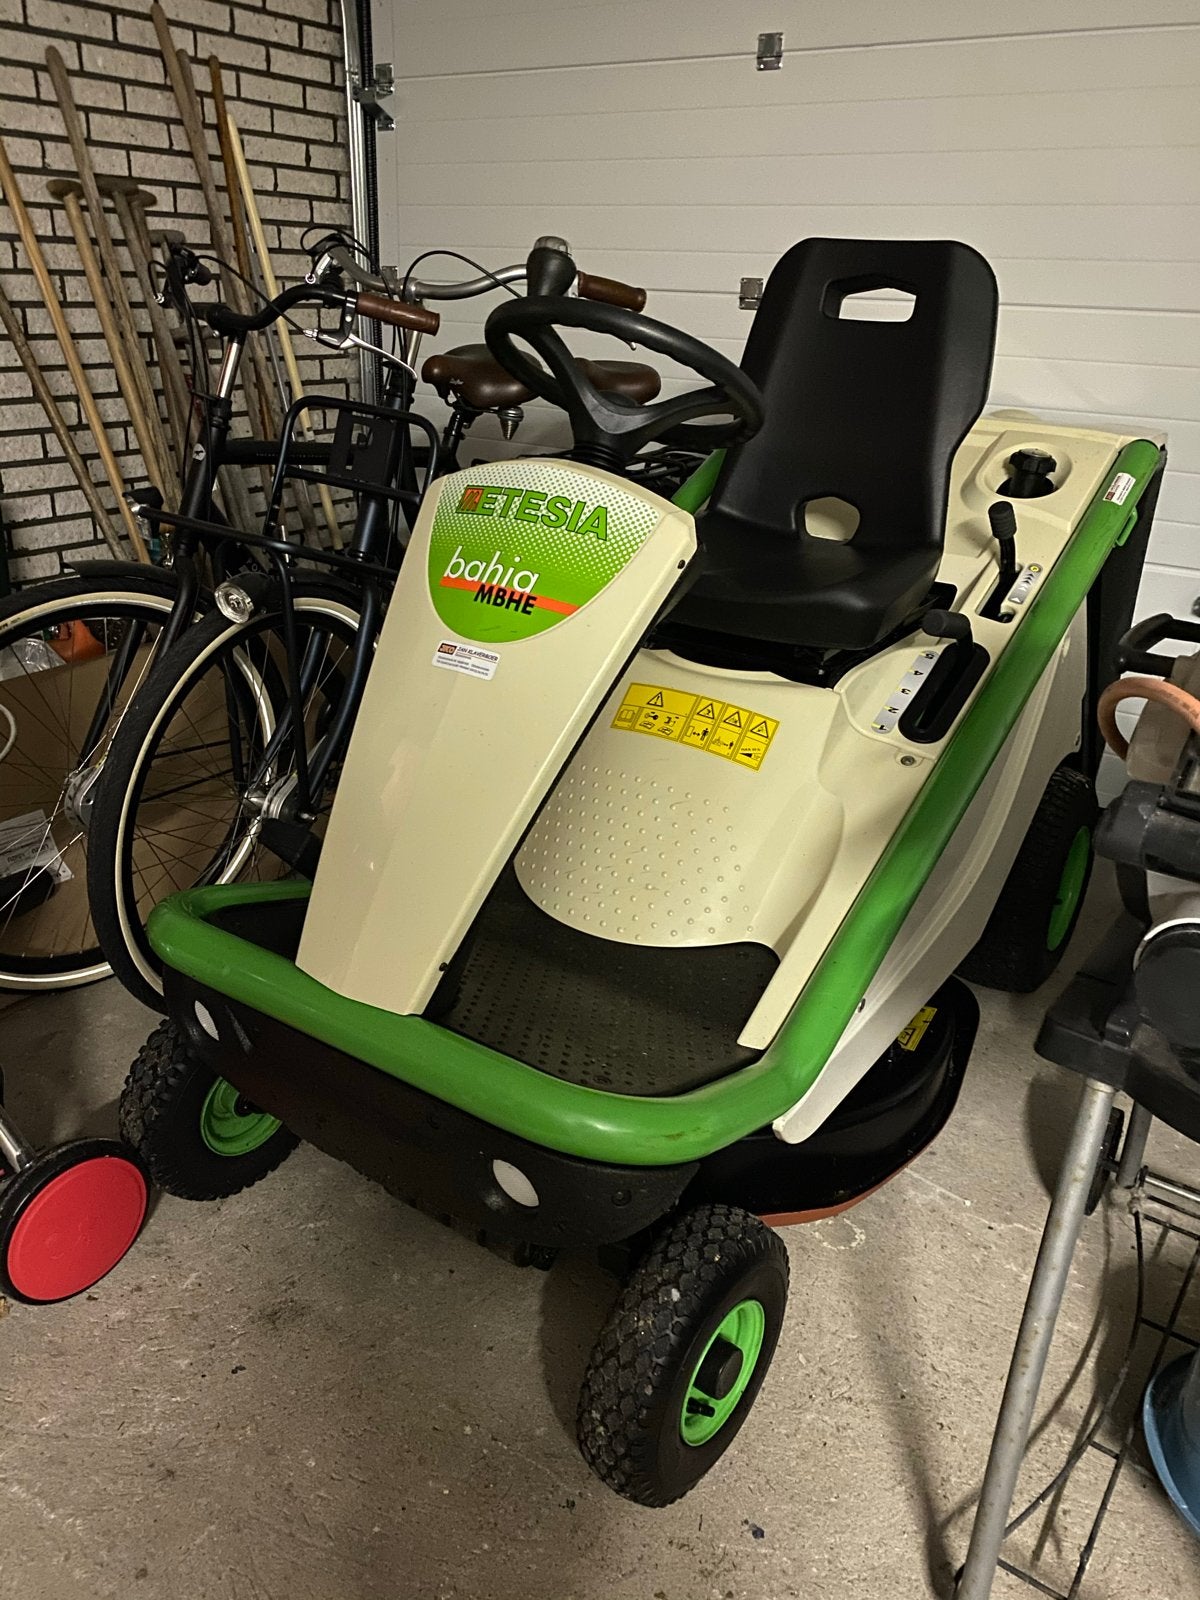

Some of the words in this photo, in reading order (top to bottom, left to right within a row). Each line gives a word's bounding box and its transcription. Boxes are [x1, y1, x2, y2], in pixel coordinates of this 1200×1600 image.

[456, 485, 608, 541] ETESIA
[444, 545, 539, 594] bahia
[473, 584, 538, 615] MBHE
